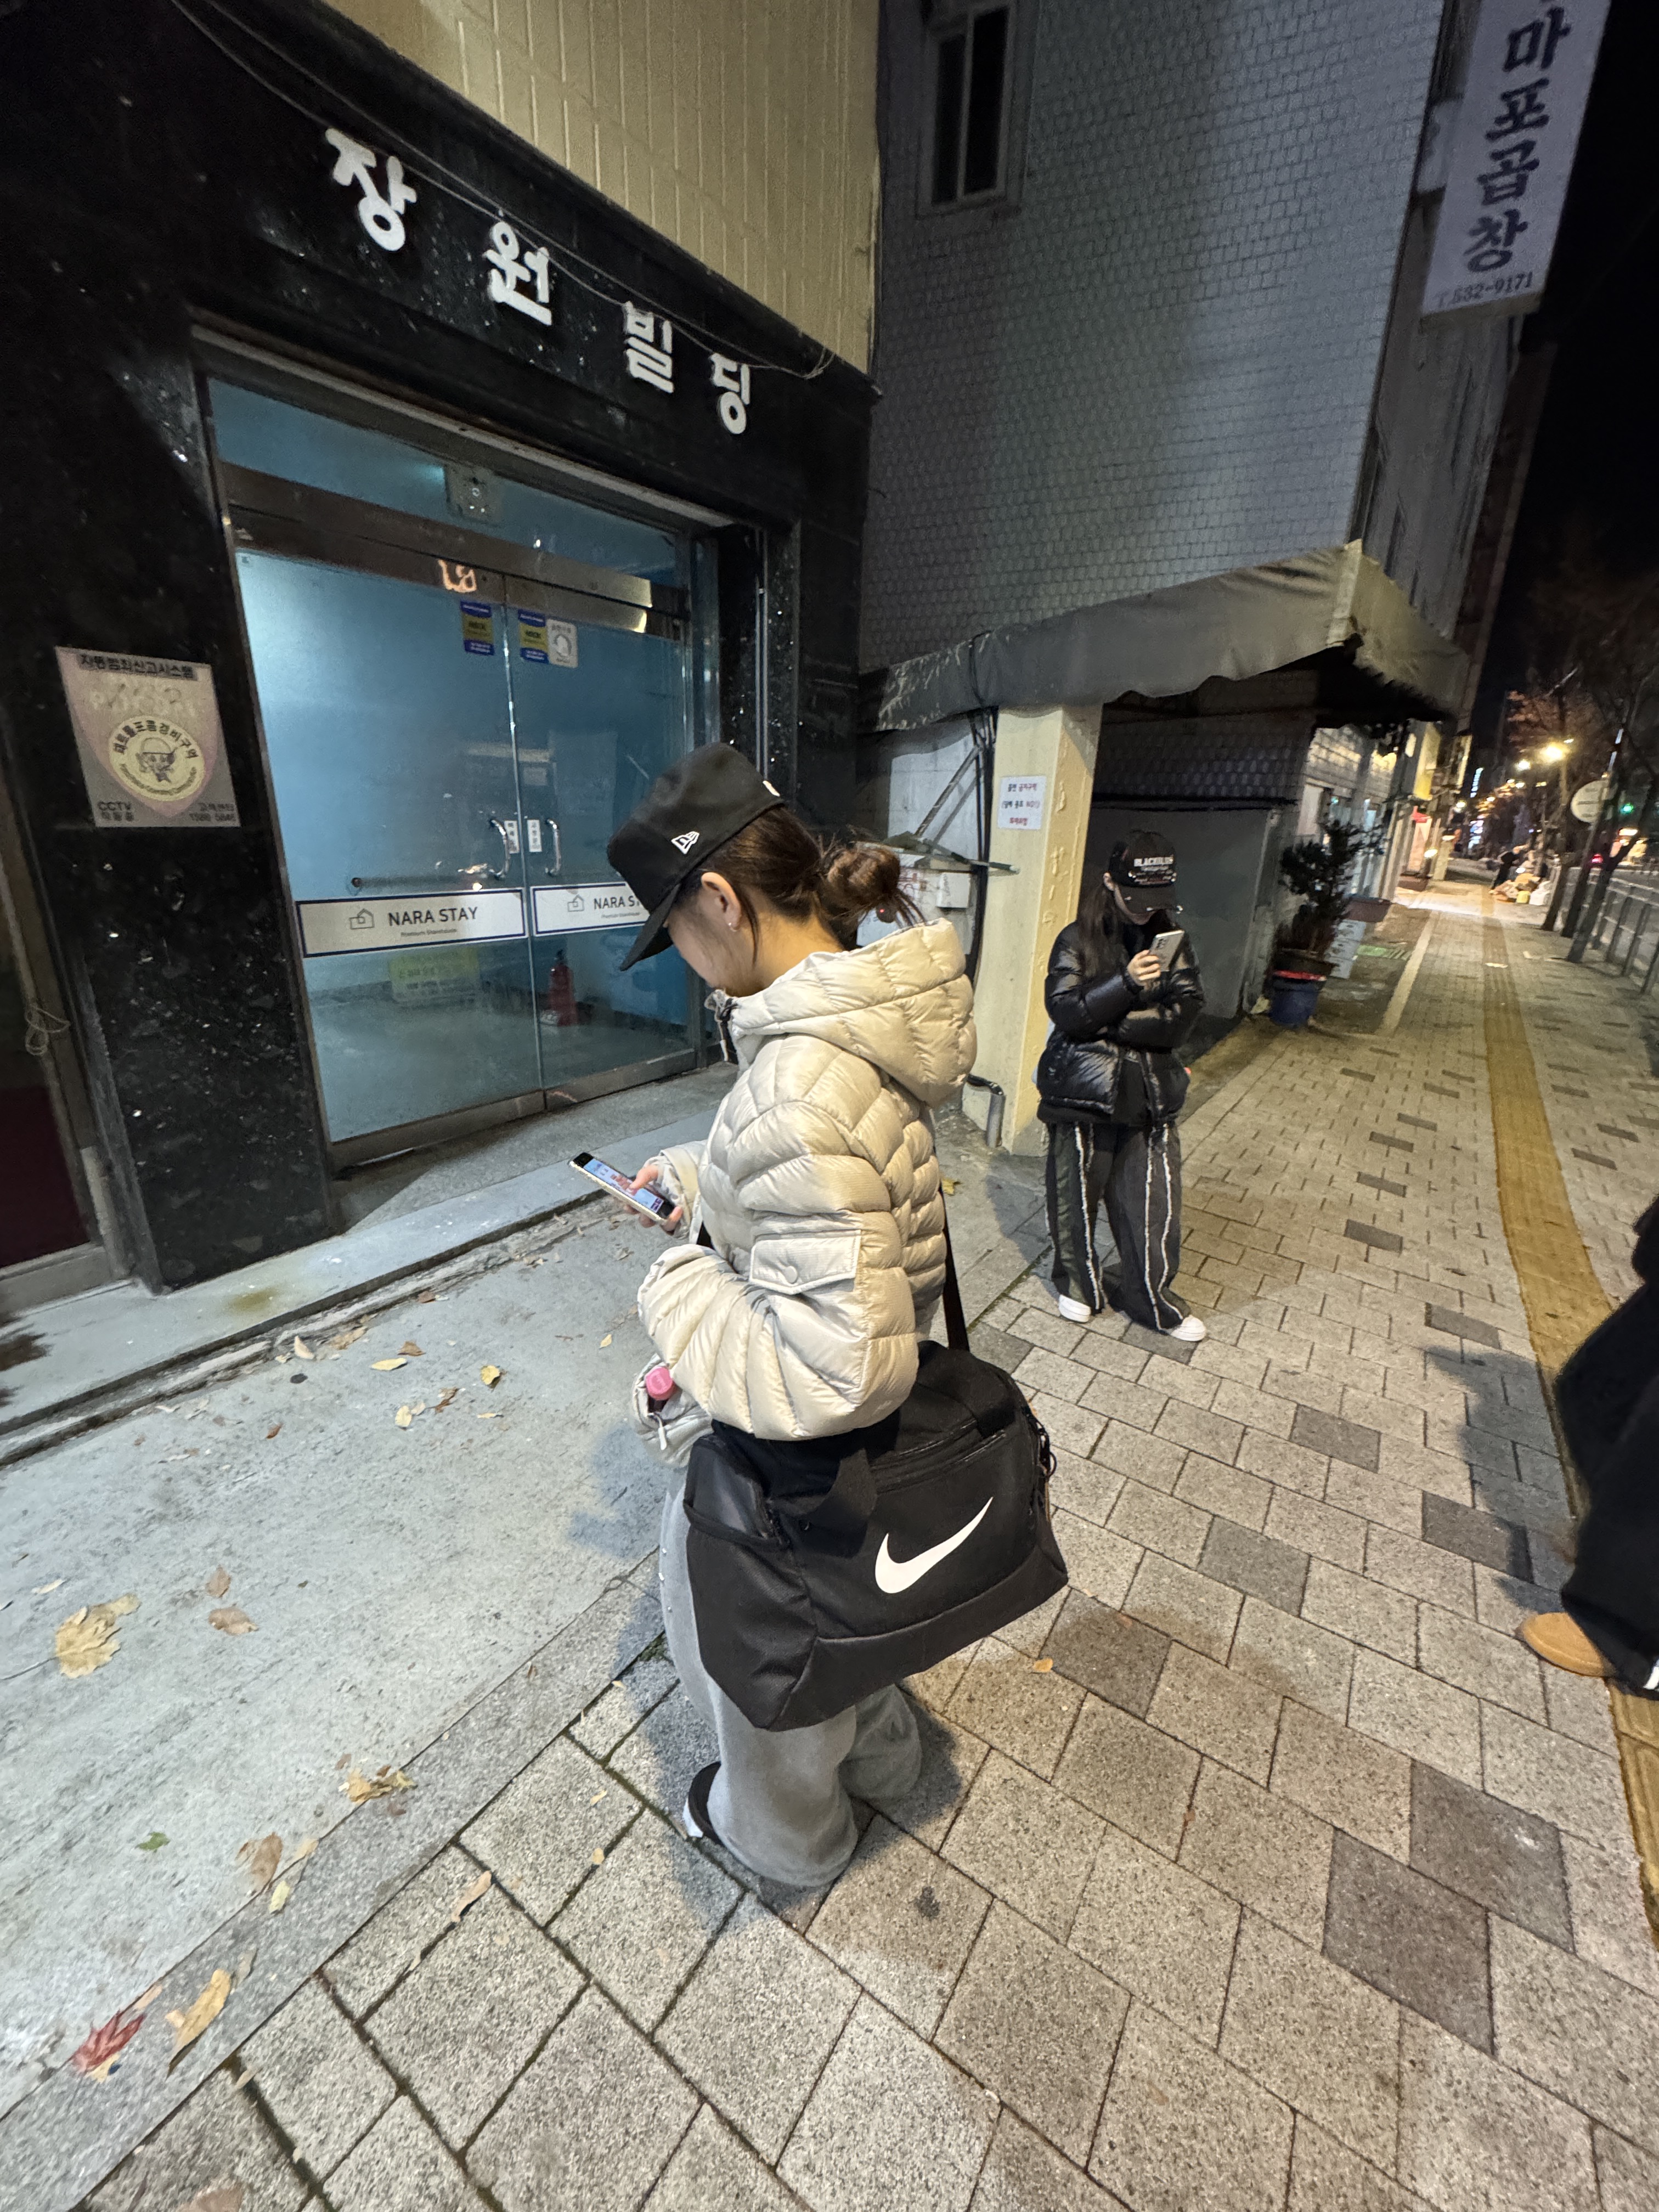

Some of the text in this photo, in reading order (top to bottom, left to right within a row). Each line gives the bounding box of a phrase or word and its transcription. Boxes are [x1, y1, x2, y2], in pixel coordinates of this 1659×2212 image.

[1463, 6, 1571, 272] 마포곱창
[326, 128, 750, 434] 장원빌딩
[388, 906, 478, 927] NARA STAY
[594, 896, 626, 910] NARA
